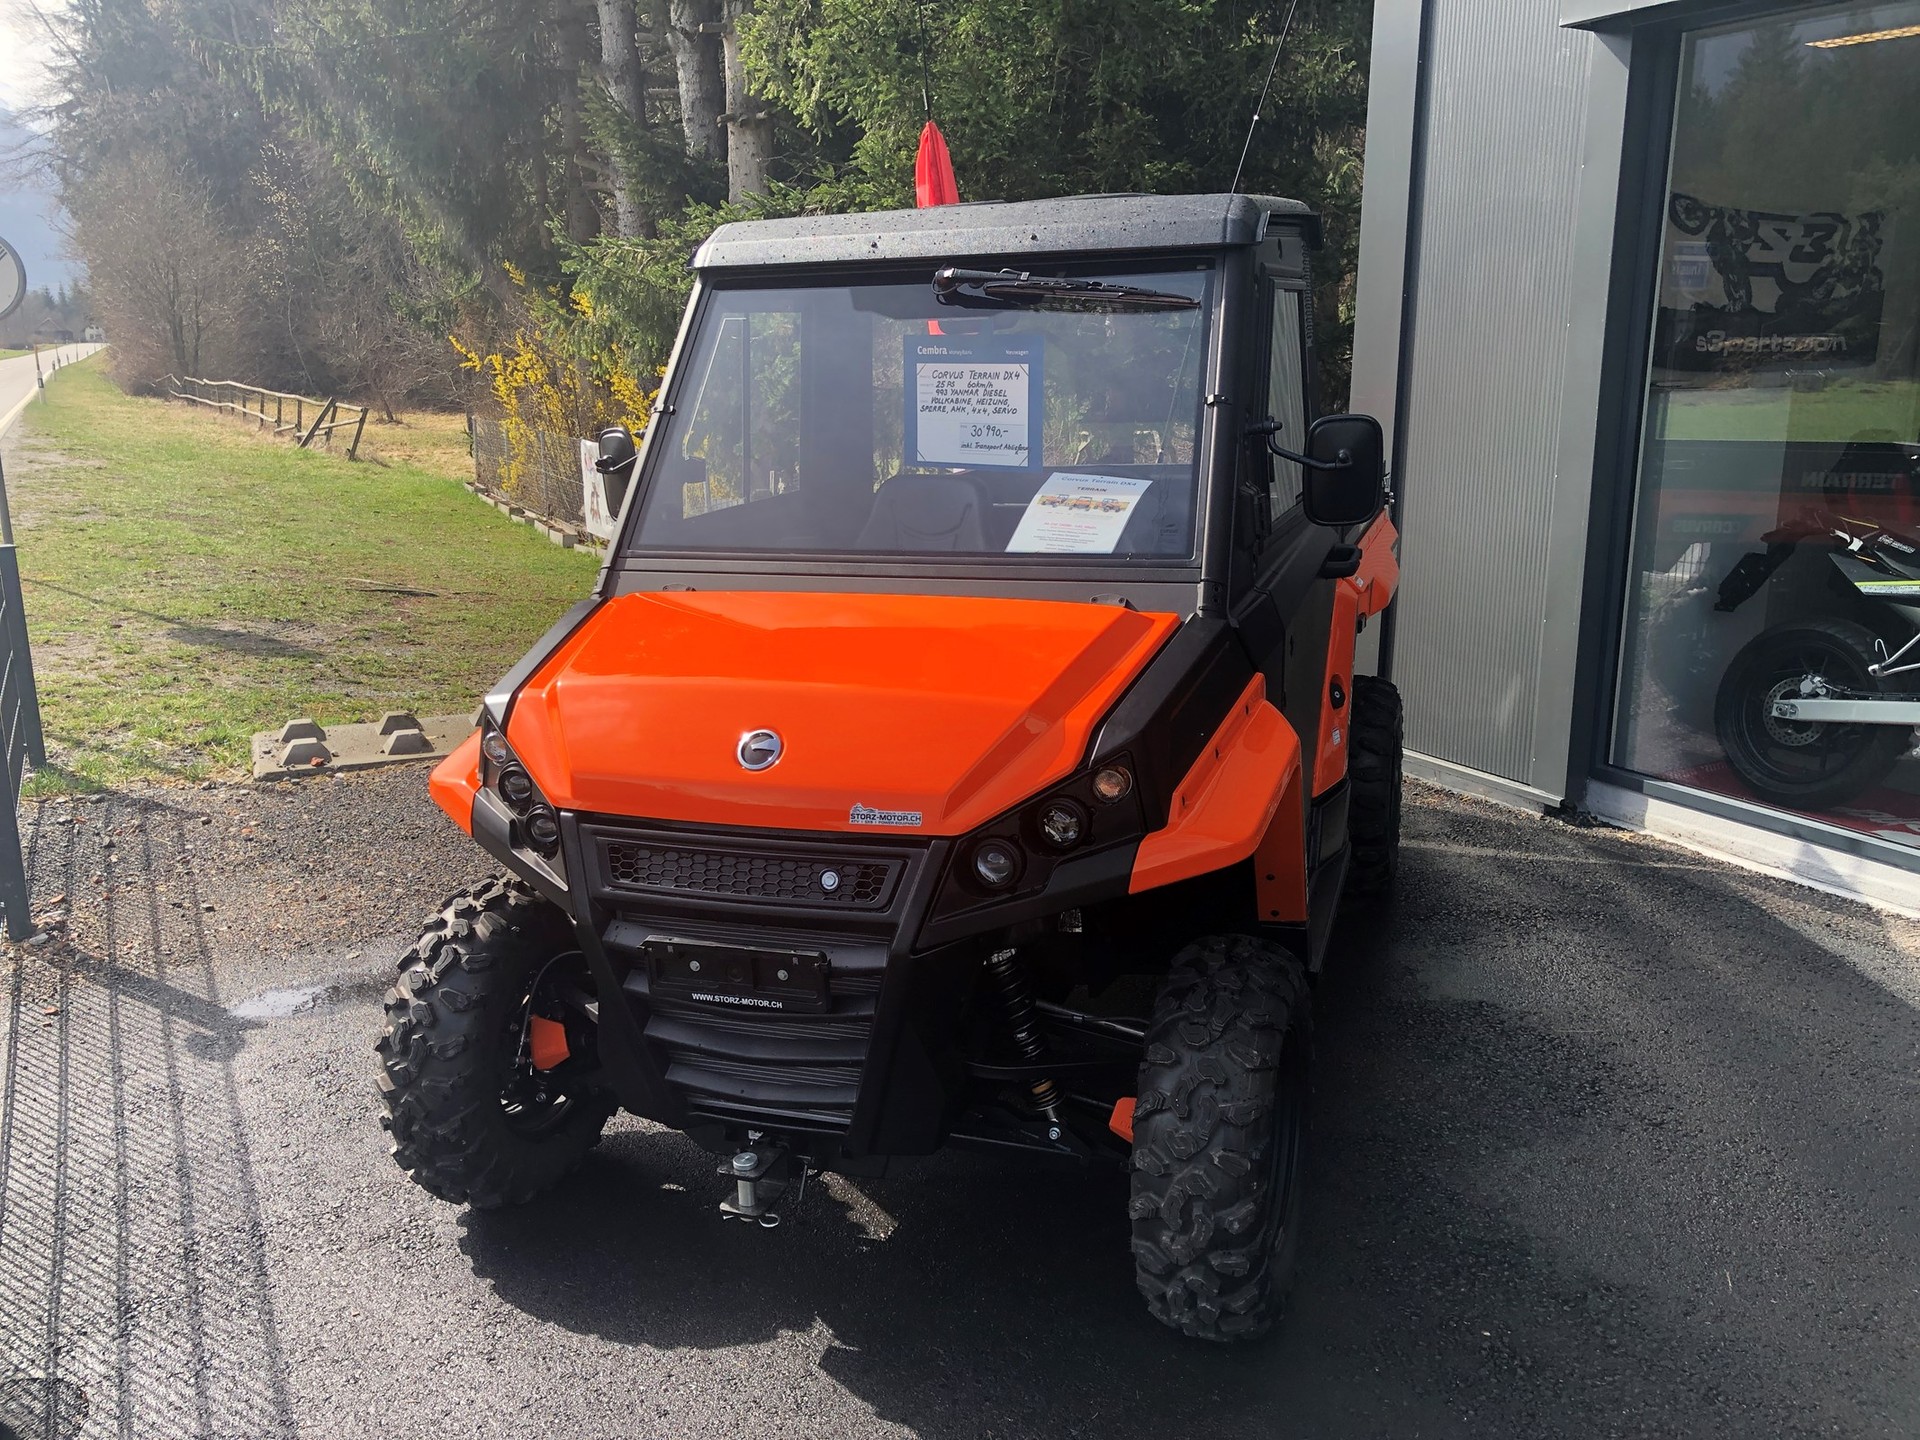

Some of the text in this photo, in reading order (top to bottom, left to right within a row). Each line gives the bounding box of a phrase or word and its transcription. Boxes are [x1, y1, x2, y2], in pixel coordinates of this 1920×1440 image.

[917, 345, 948, 355] Cembra
[931, 369, 1020, 381] CORVUS TERRAIN DX4
[935, 380, 946, 388] 25
[946, 380, 955, 388] PS
[967, 380, 994, 389] 60km/h
[935, 388, 948, 396] 993
[950, 388, 979, 397] YANMAR
[983, 389, 1007, 398] DIESEL
[976, 398, 1010, 408] HEIZUNG,
[919, 405, 949, 414] SPERRE,
[992, 406, 1018, 415] SERVO
[975, 441, 1003, 451] Transport
[1091, 477, 1118, 486] Terrain
[691, 993, 783, 1008] WWW.STORZ-MOTOR.CH
